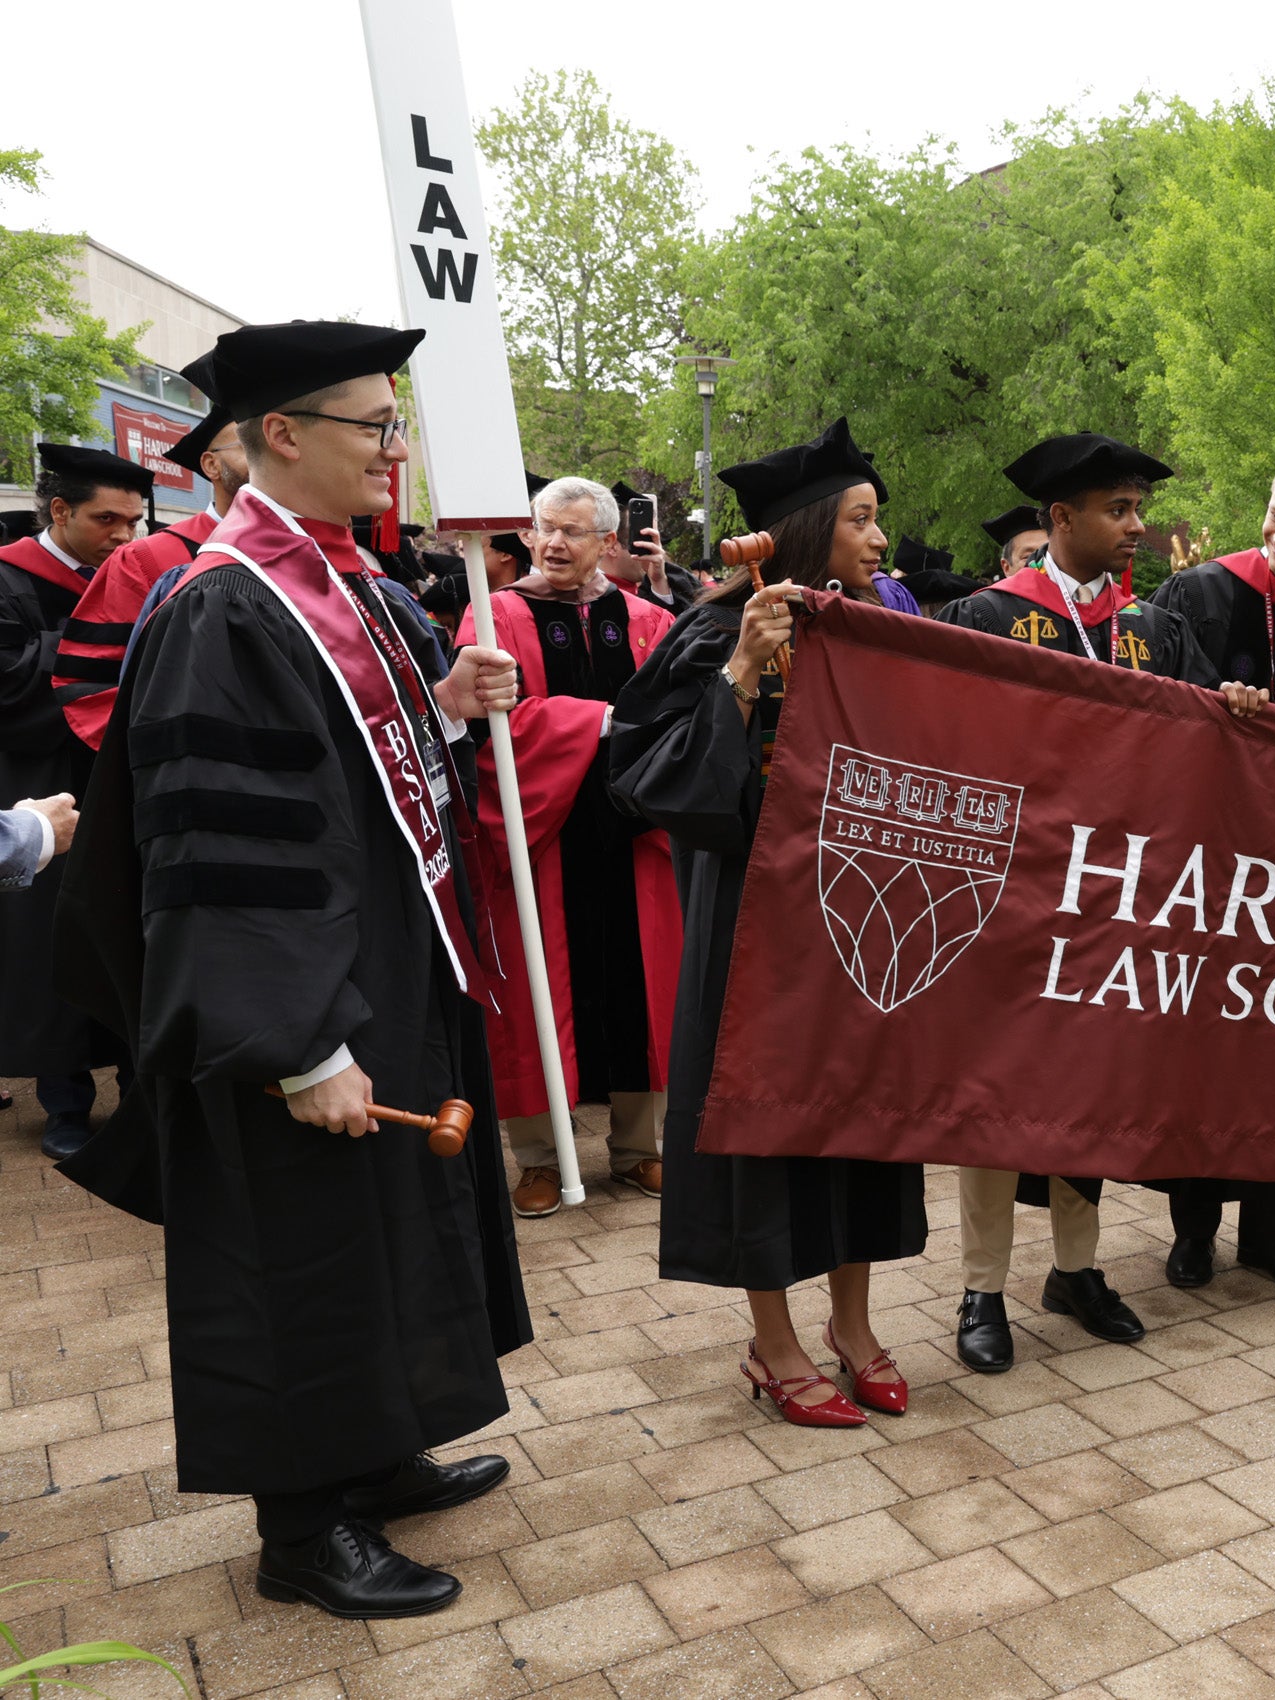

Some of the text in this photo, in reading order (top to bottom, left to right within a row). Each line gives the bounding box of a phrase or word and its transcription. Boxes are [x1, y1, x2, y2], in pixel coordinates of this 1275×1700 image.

[410, 113, 479, 303] LAW
[1265, 592, 1273, 639] UNIVERSITY
[376, 626, 405, 669] HARVARD
[381, 719, 438, 842] BSA
[854, 772, 996, 818] VE RI TAS
[836, 820, 996, 866] LEX ET IUSTITIA
[1039, 937, 1207, 1016] LAW
